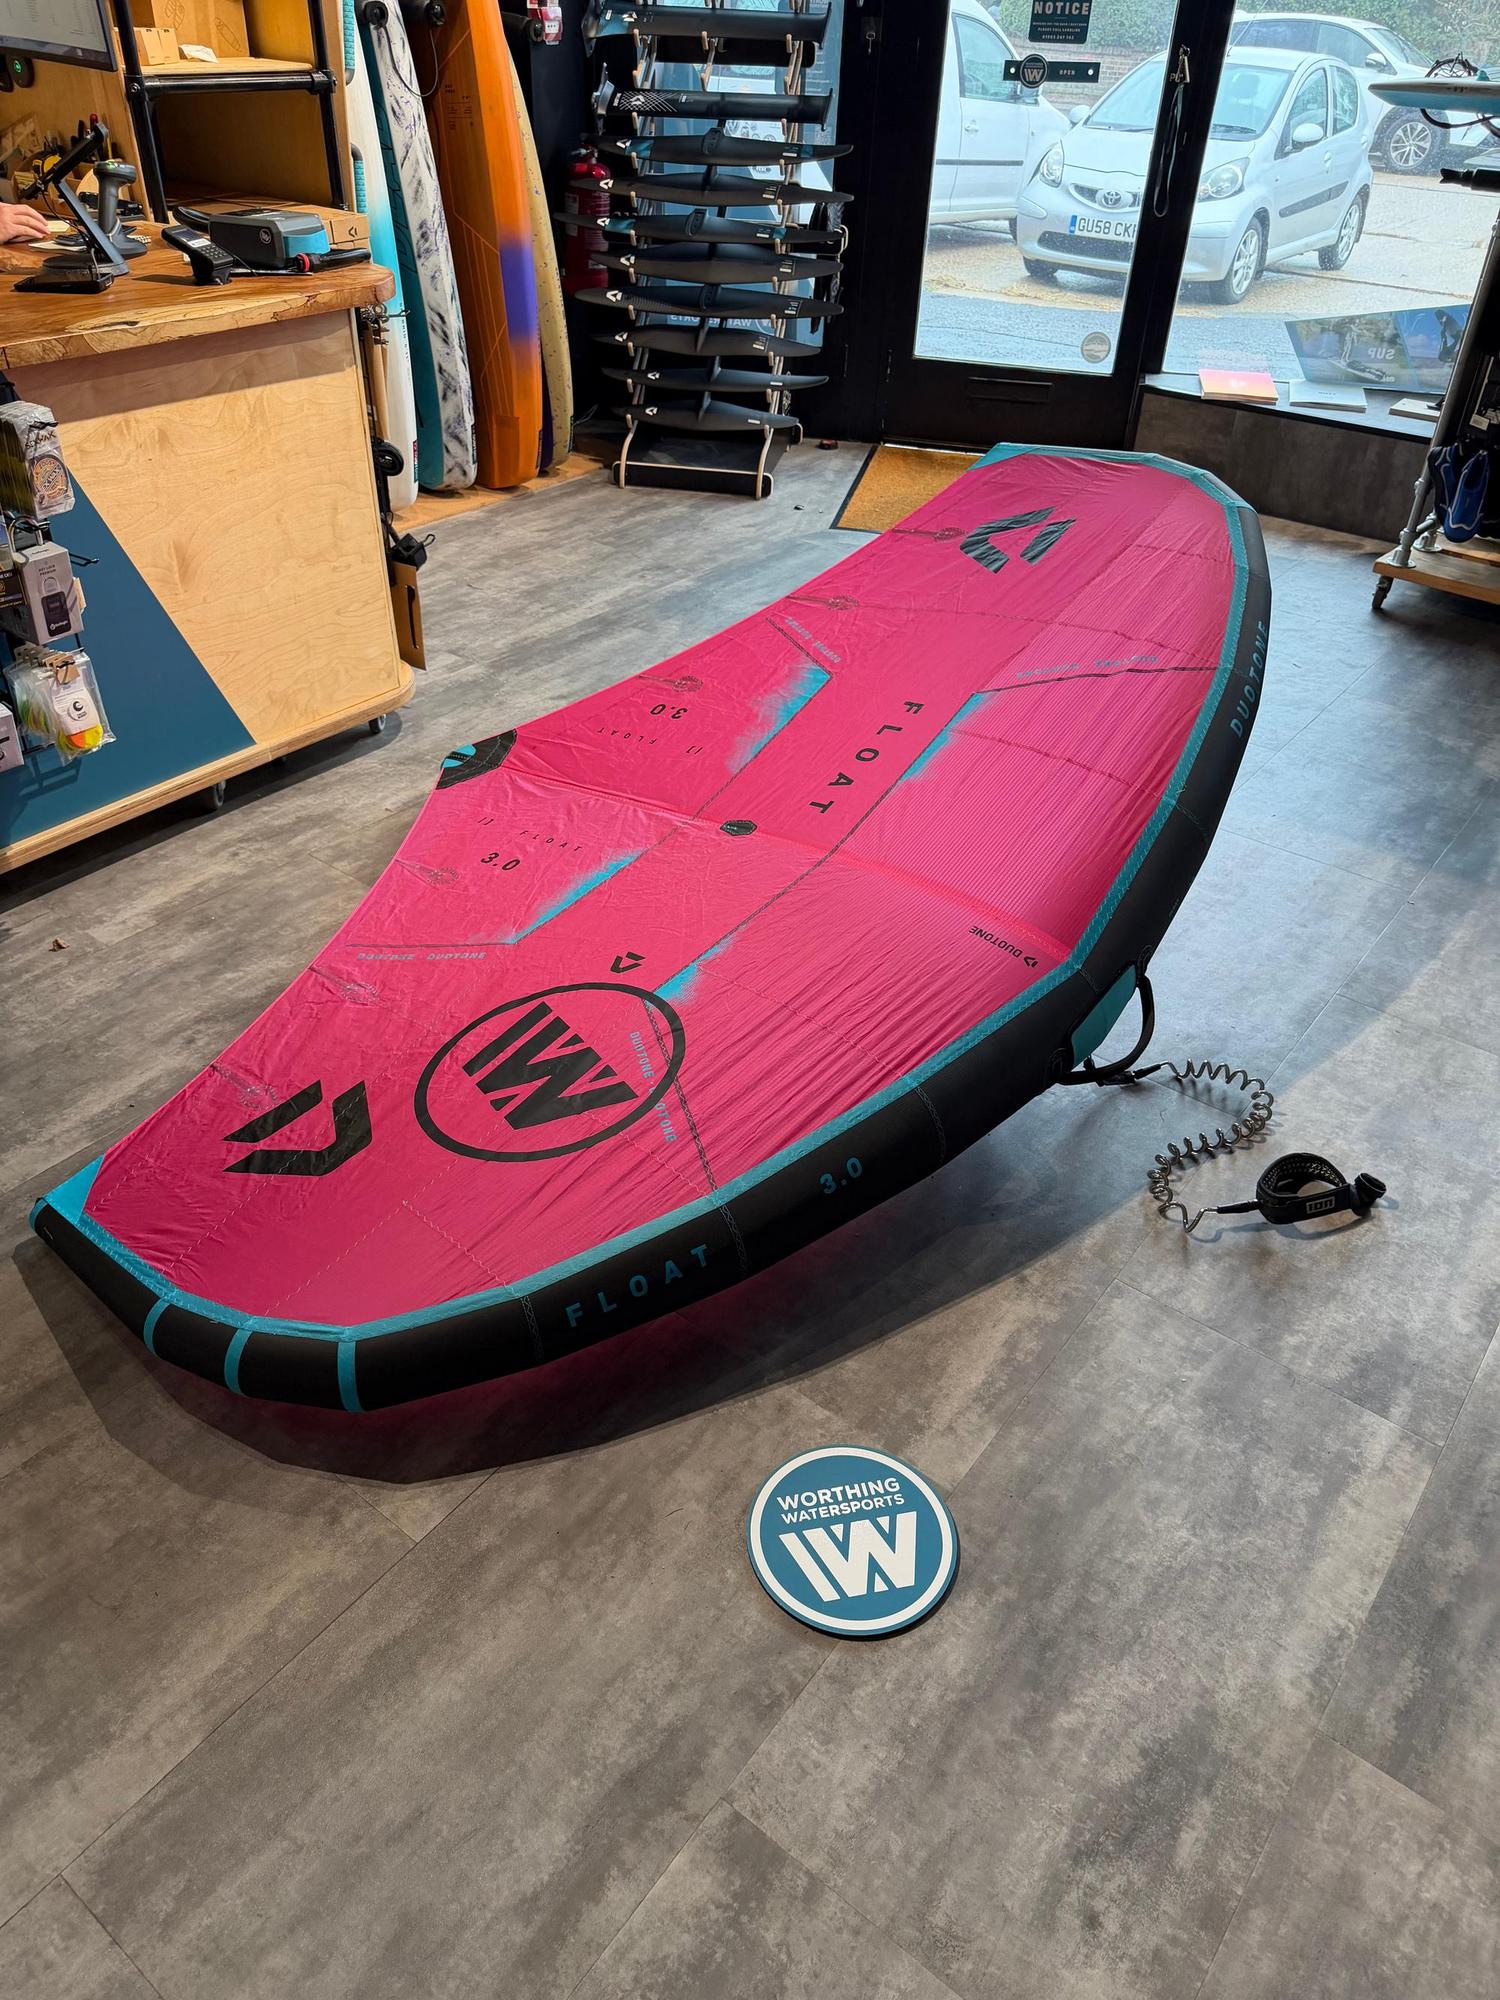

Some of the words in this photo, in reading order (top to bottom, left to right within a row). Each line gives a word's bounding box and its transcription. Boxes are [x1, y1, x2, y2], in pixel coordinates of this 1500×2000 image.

[1034, 2, 1090, 15] NOTICE
[1078, 218, 1112, 235] GU58
[649, 703, 688, 719] 3.0
[597, 727, 658, 745] FLOAT
[809, 701, 925, 814] FLOAT
[519, 830, 582, 852] FLOAT
[480, 852, 521, 871] 3.0
[969, 925, 1024, 958] DUOTONE
[819, 1157, 863, 1194] 3.0
[565, 1244, 708, 1328] FLOAT
[776, 1477, 901, 1511] WORTHING
[781, 1493, 905, 1524] WATERSPORTS
